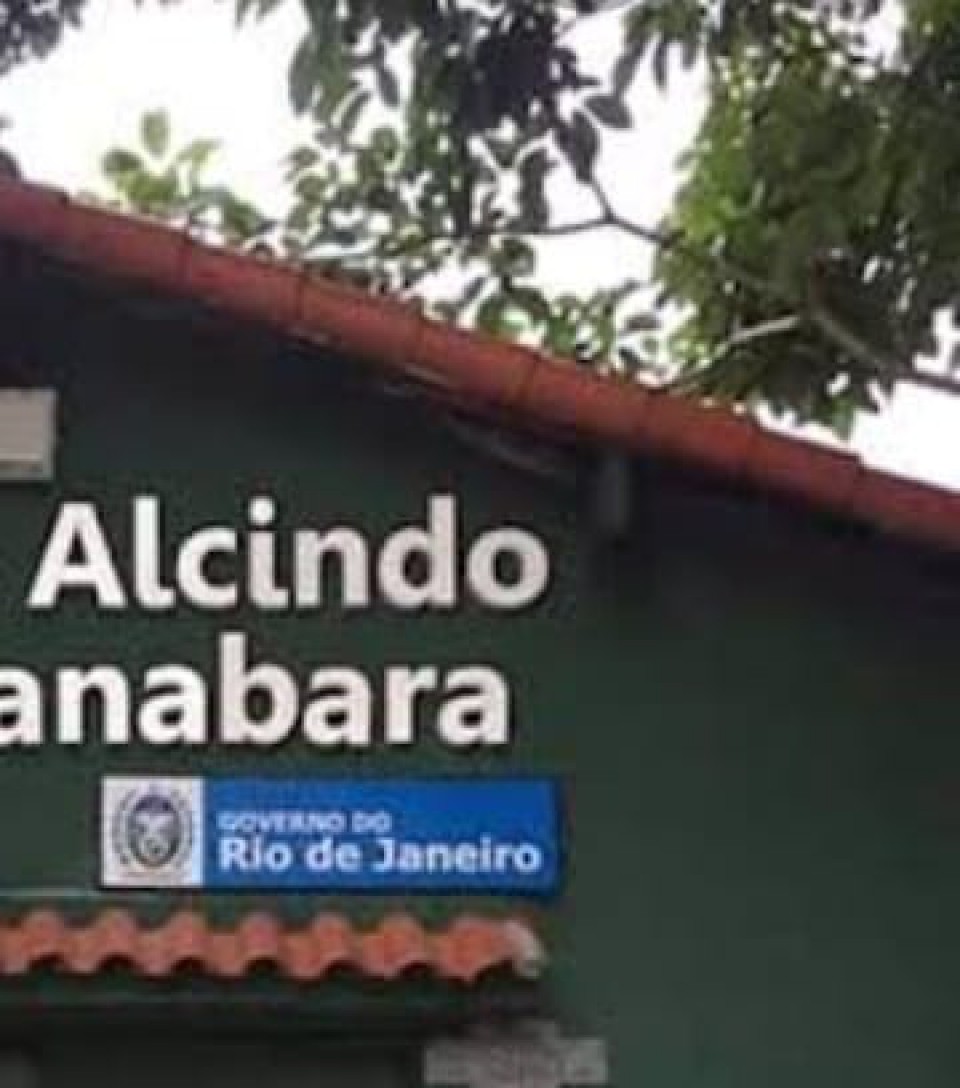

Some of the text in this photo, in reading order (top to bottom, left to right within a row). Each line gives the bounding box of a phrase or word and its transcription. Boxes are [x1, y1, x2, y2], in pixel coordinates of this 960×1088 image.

[28, 495, 552, 611] Alcindo
[216, 810, 392, 832] GOVERNO DO
[218, 836, 542, 873] Rio de Janeiro
